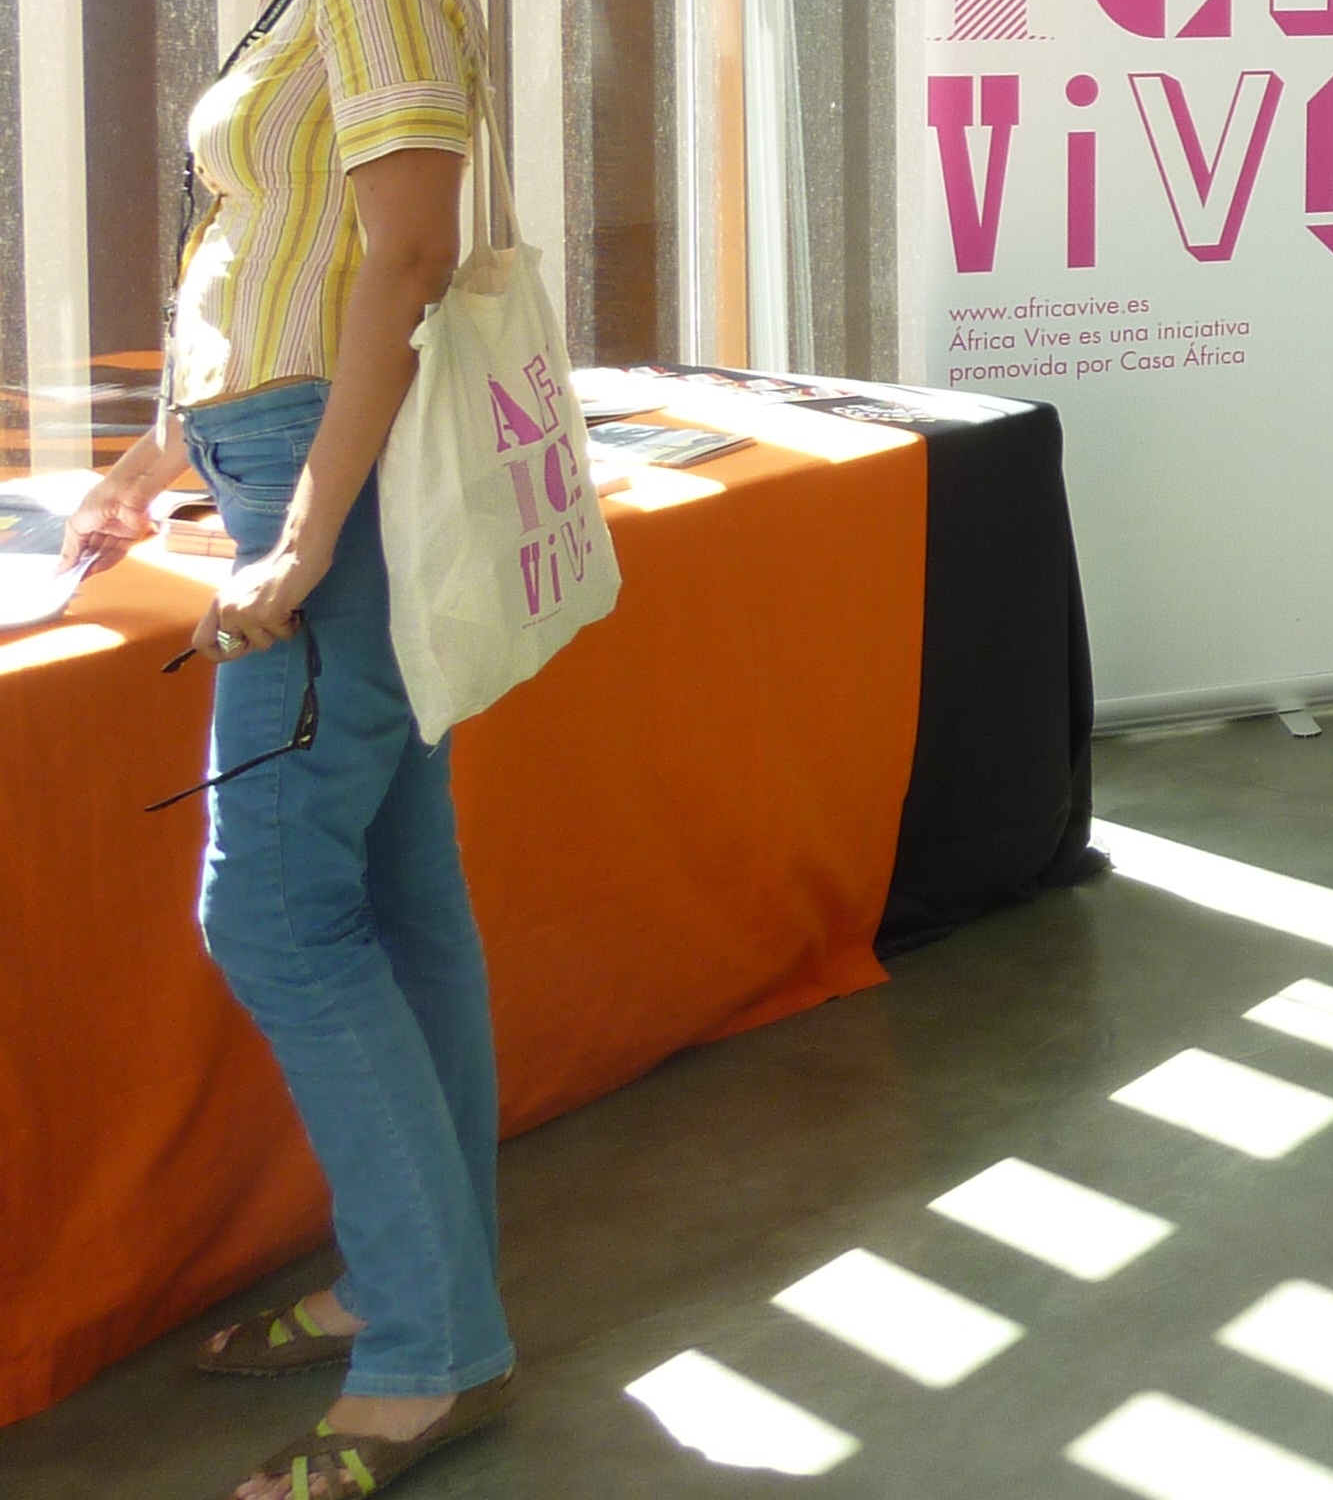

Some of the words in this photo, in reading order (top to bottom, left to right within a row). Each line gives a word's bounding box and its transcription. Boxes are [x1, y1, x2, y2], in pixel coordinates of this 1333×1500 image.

[948, 297, 1150, 321] www.africavive.es
[948, 326, 1016, 351] África
[1024, 327, 1071, 348] Vive
[1079, 330, 1102, 345] es
[1110, 327, 1149, 343] una
[1157, 319, 1250, 340] iniciativa
[949, 355, 1068, 387] promovida
[1076, 358, 1113, 380] por
[1120, 350, 1176, 371] Casa
[1183, 342, 1246, 367] África
